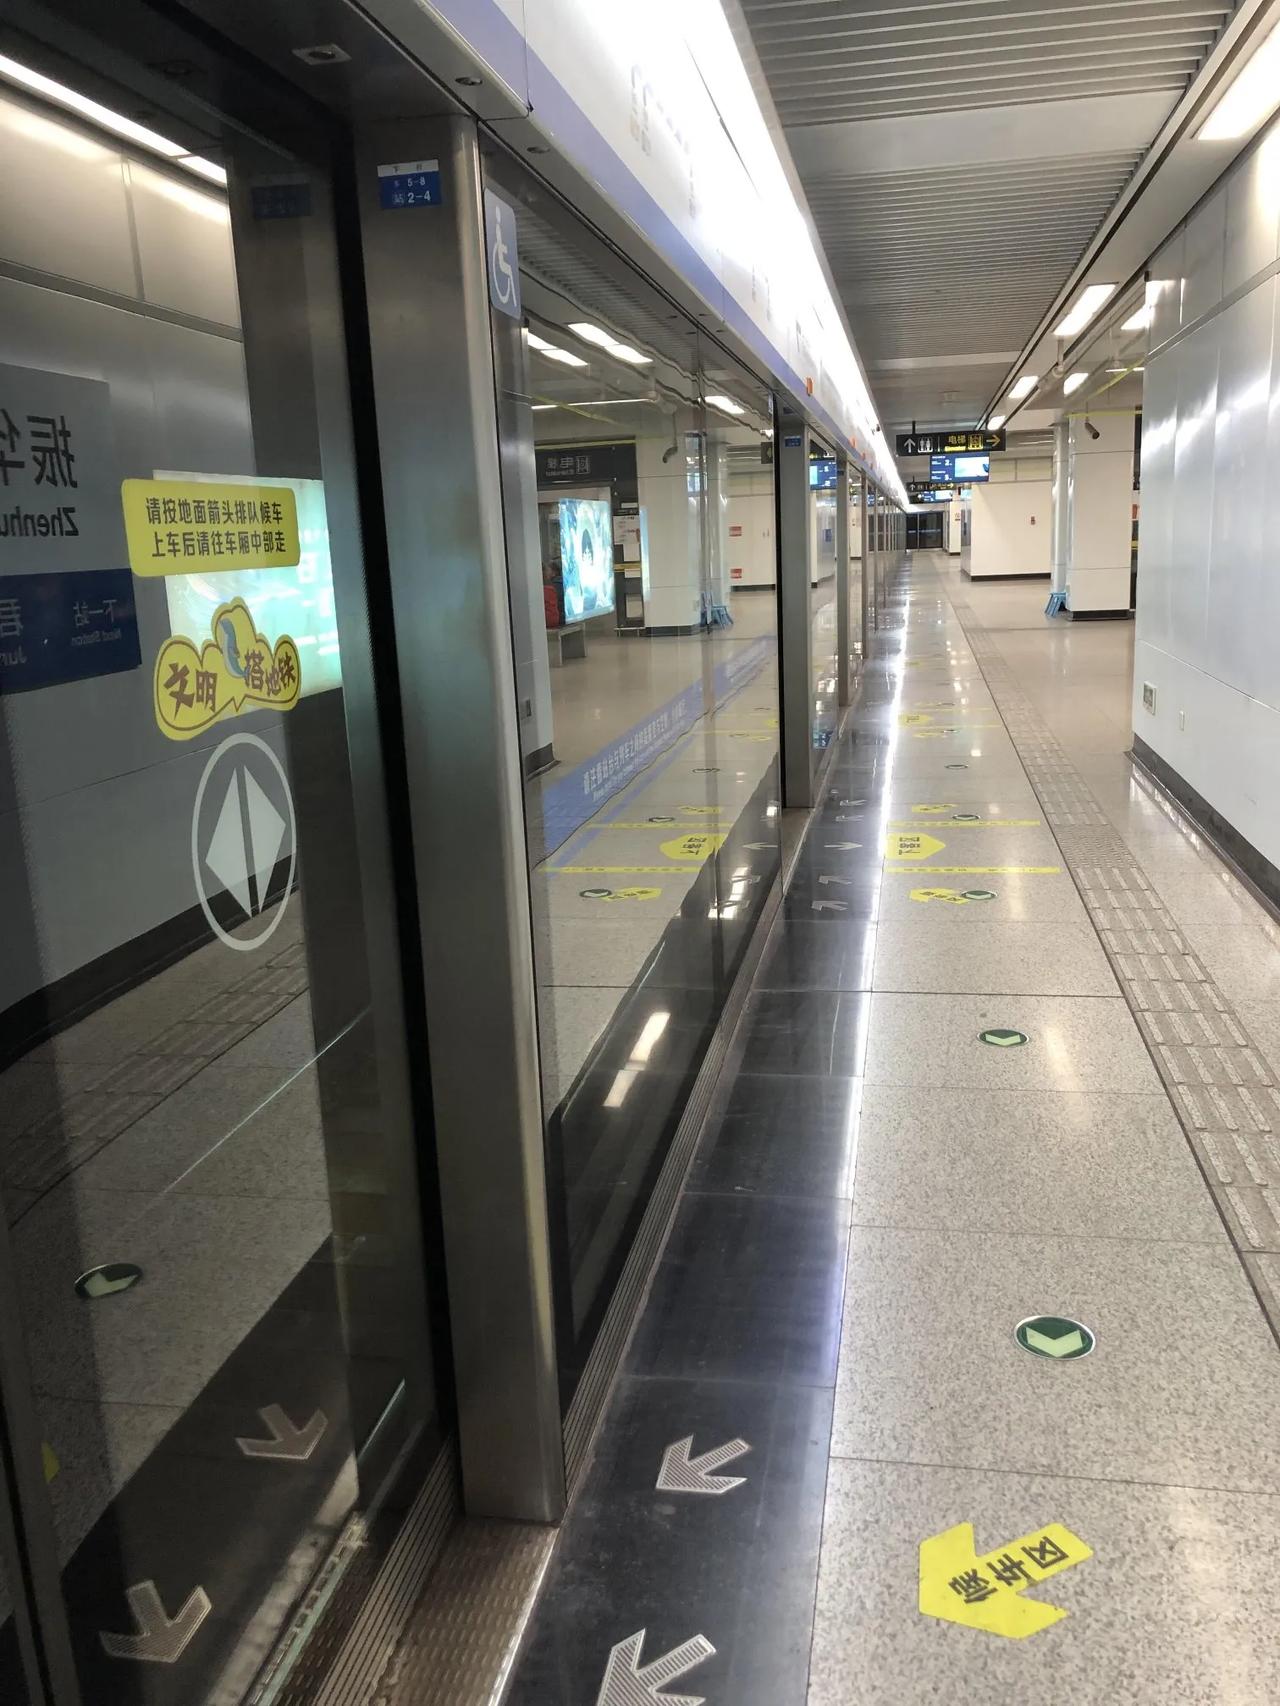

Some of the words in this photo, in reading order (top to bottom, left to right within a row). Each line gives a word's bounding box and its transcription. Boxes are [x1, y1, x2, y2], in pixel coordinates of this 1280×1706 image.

[145, 497, 283, 526] 请按地面箭头排队候车
[151, 531, 287, 558] 上车后请往车厢中部走
[163, 662, 218, 720] 文明
[947, 1535, 1069, 1604] 候车区
